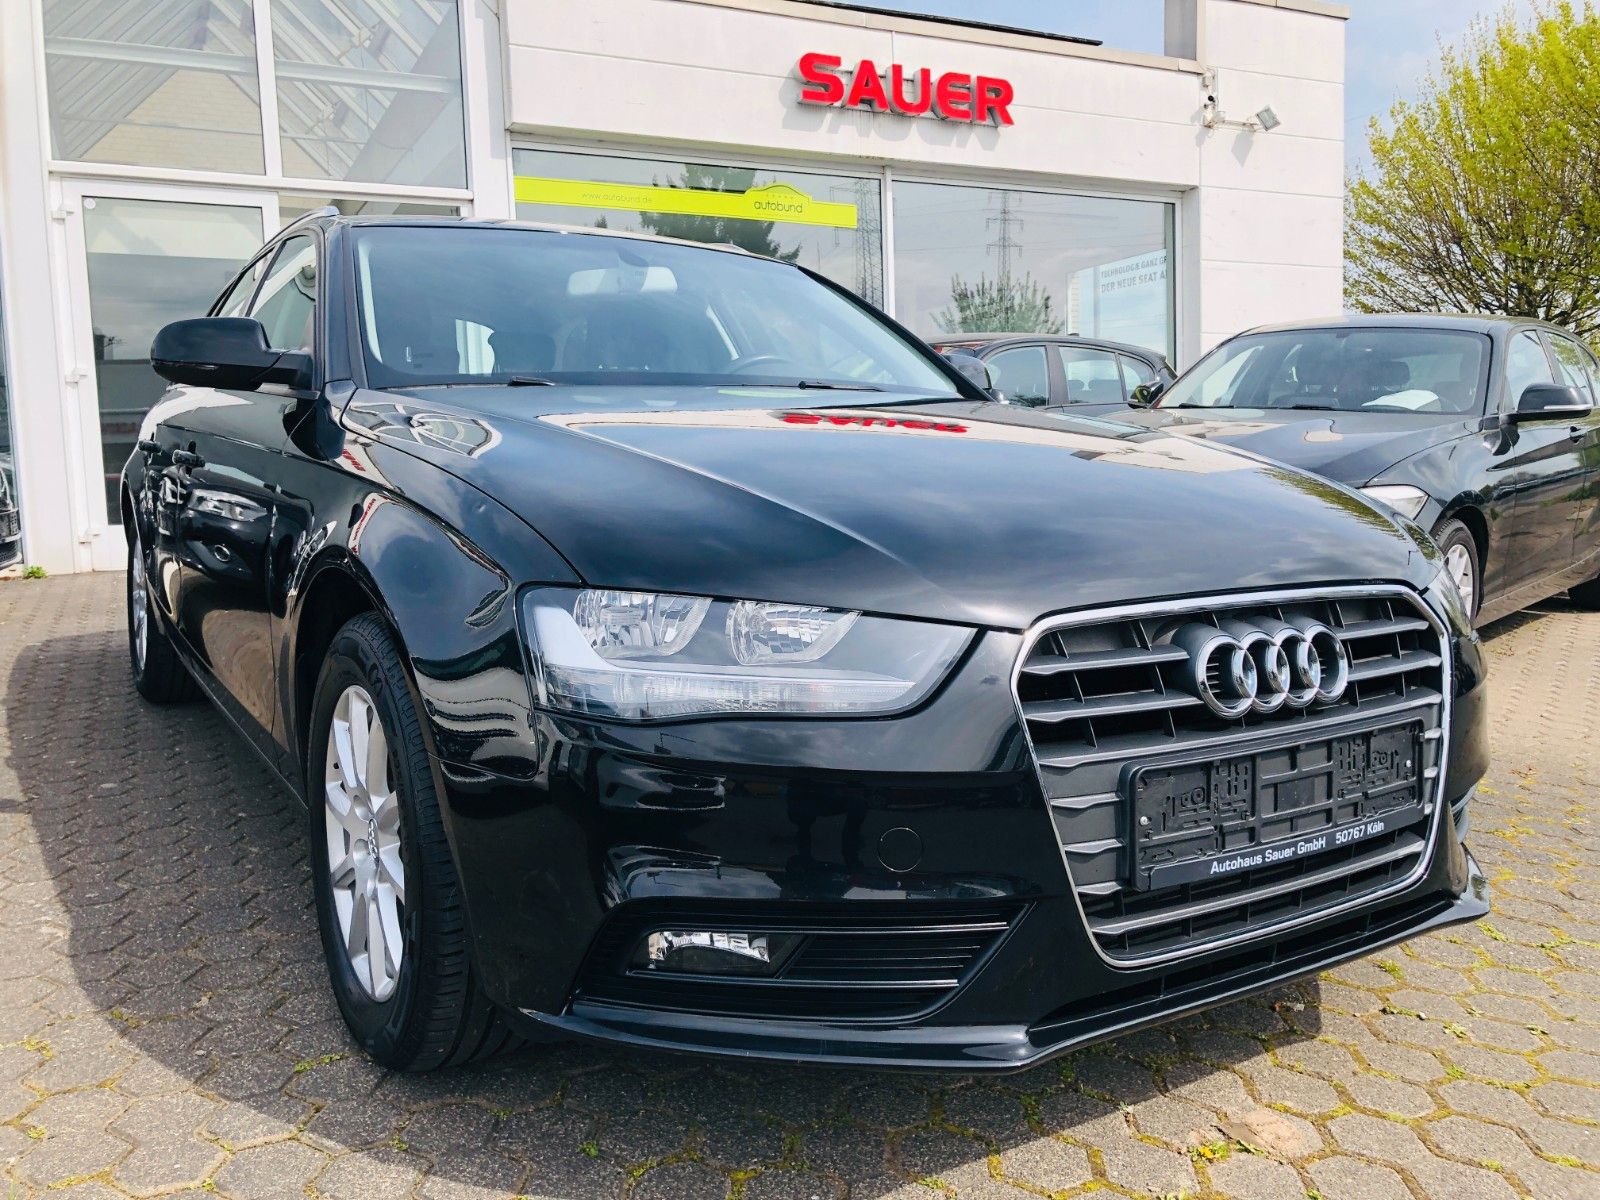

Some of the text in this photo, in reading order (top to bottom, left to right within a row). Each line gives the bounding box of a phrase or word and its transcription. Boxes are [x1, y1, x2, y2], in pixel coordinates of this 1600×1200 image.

[798, 52, 1015, 126] SAUER
[753, 200, 803, 213] autobund
[1101, 281, 1115, 293] DER
[1117, 276, 1136, 289] NEUE
[1138, 271, 1158, 285] SEAT
[1210, 820, 1385, 875] Autohaus Sauer GmbH 50767 Köln
